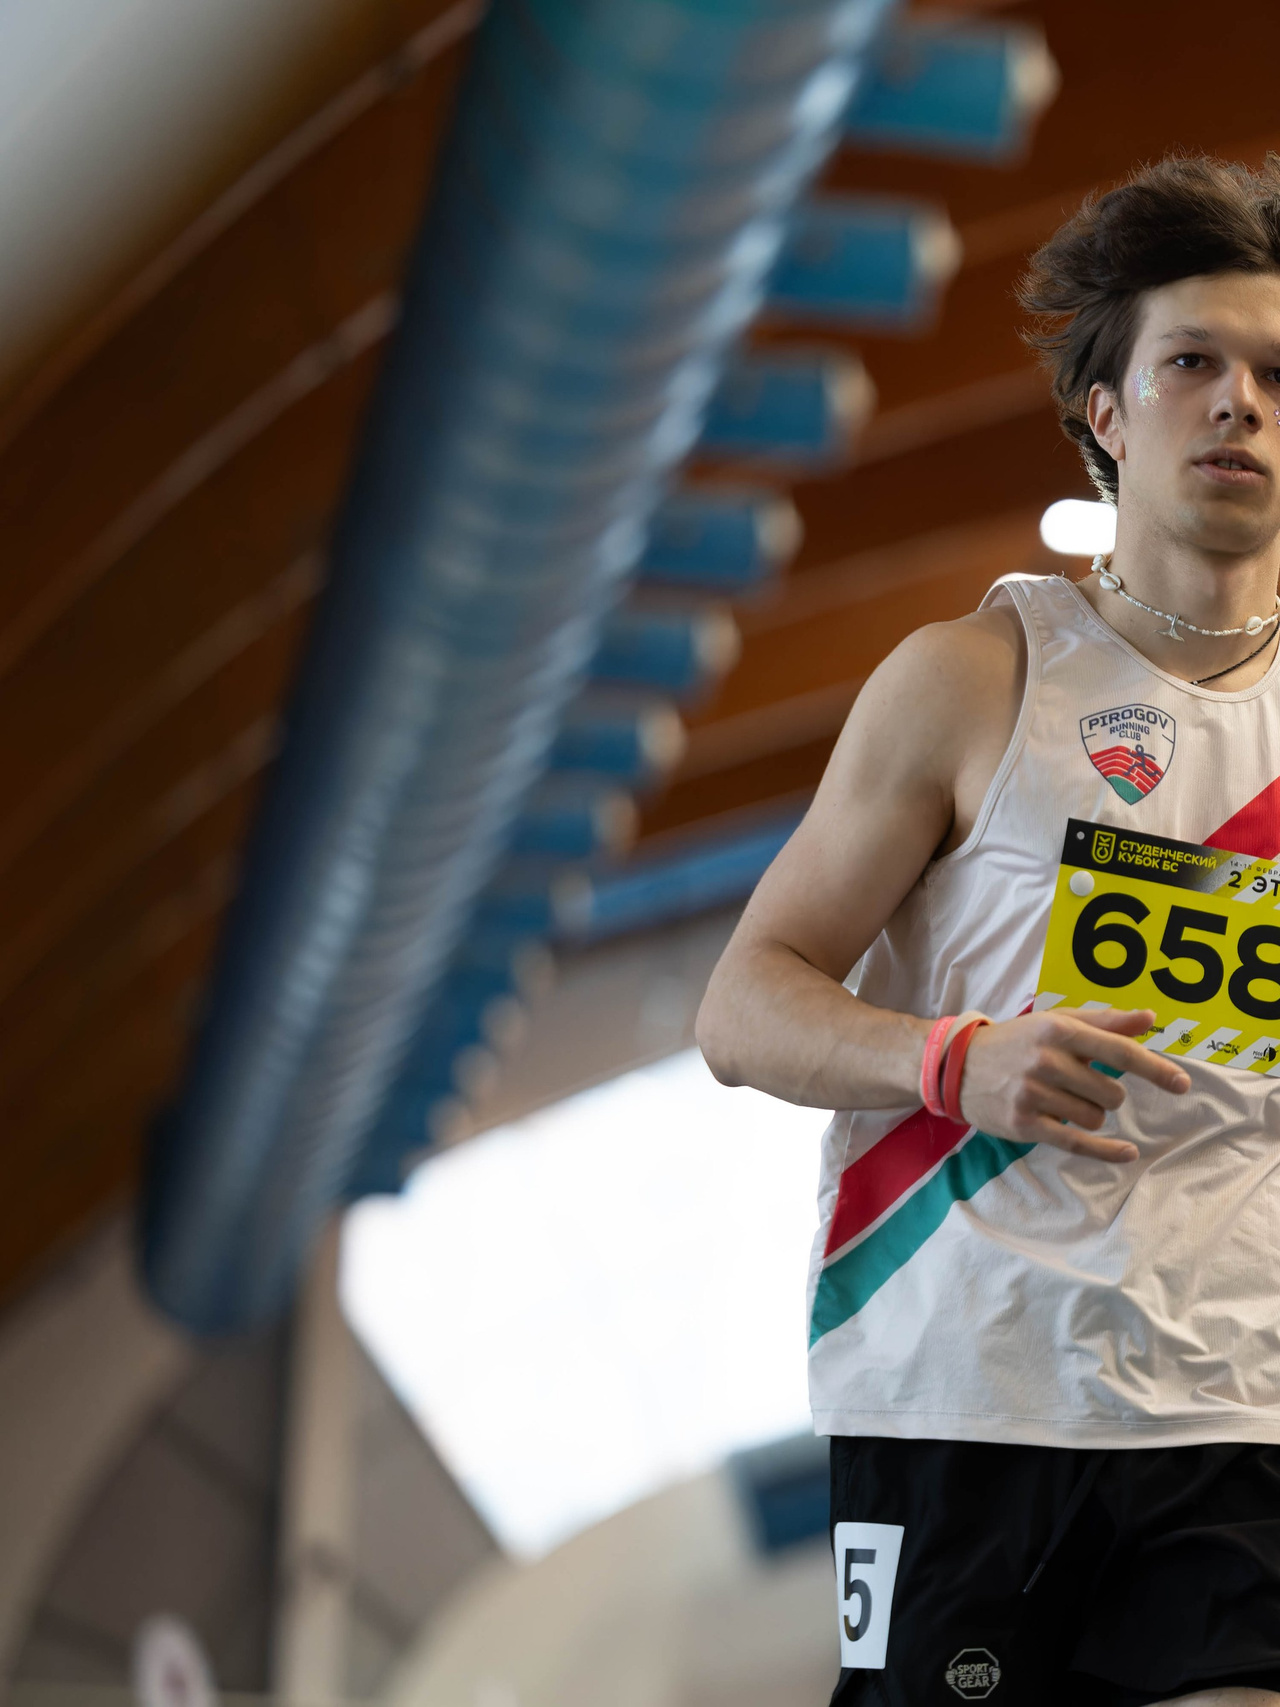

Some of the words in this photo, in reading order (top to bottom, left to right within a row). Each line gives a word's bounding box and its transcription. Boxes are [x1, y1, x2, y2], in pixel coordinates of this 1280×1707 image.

[1088, 708, 1168, 730] PIROGOV
[1109, 722, 1150, 735] RUNNING
[1118, 730, 1142, 741] CLUB
[1118, 851, 1160, 869] КУБОК
[1162, 860, 1179, 873] БС
[1119, 840, 1217, 869] СТУДЕНЧЕСКИЙ
[1228, 870, 1242, 889] 2
[844, 1548, 876, 1642] 5
[957, 1662, 989, 1674] SPORT
[958, 1675, 990, 1689] GEAR
